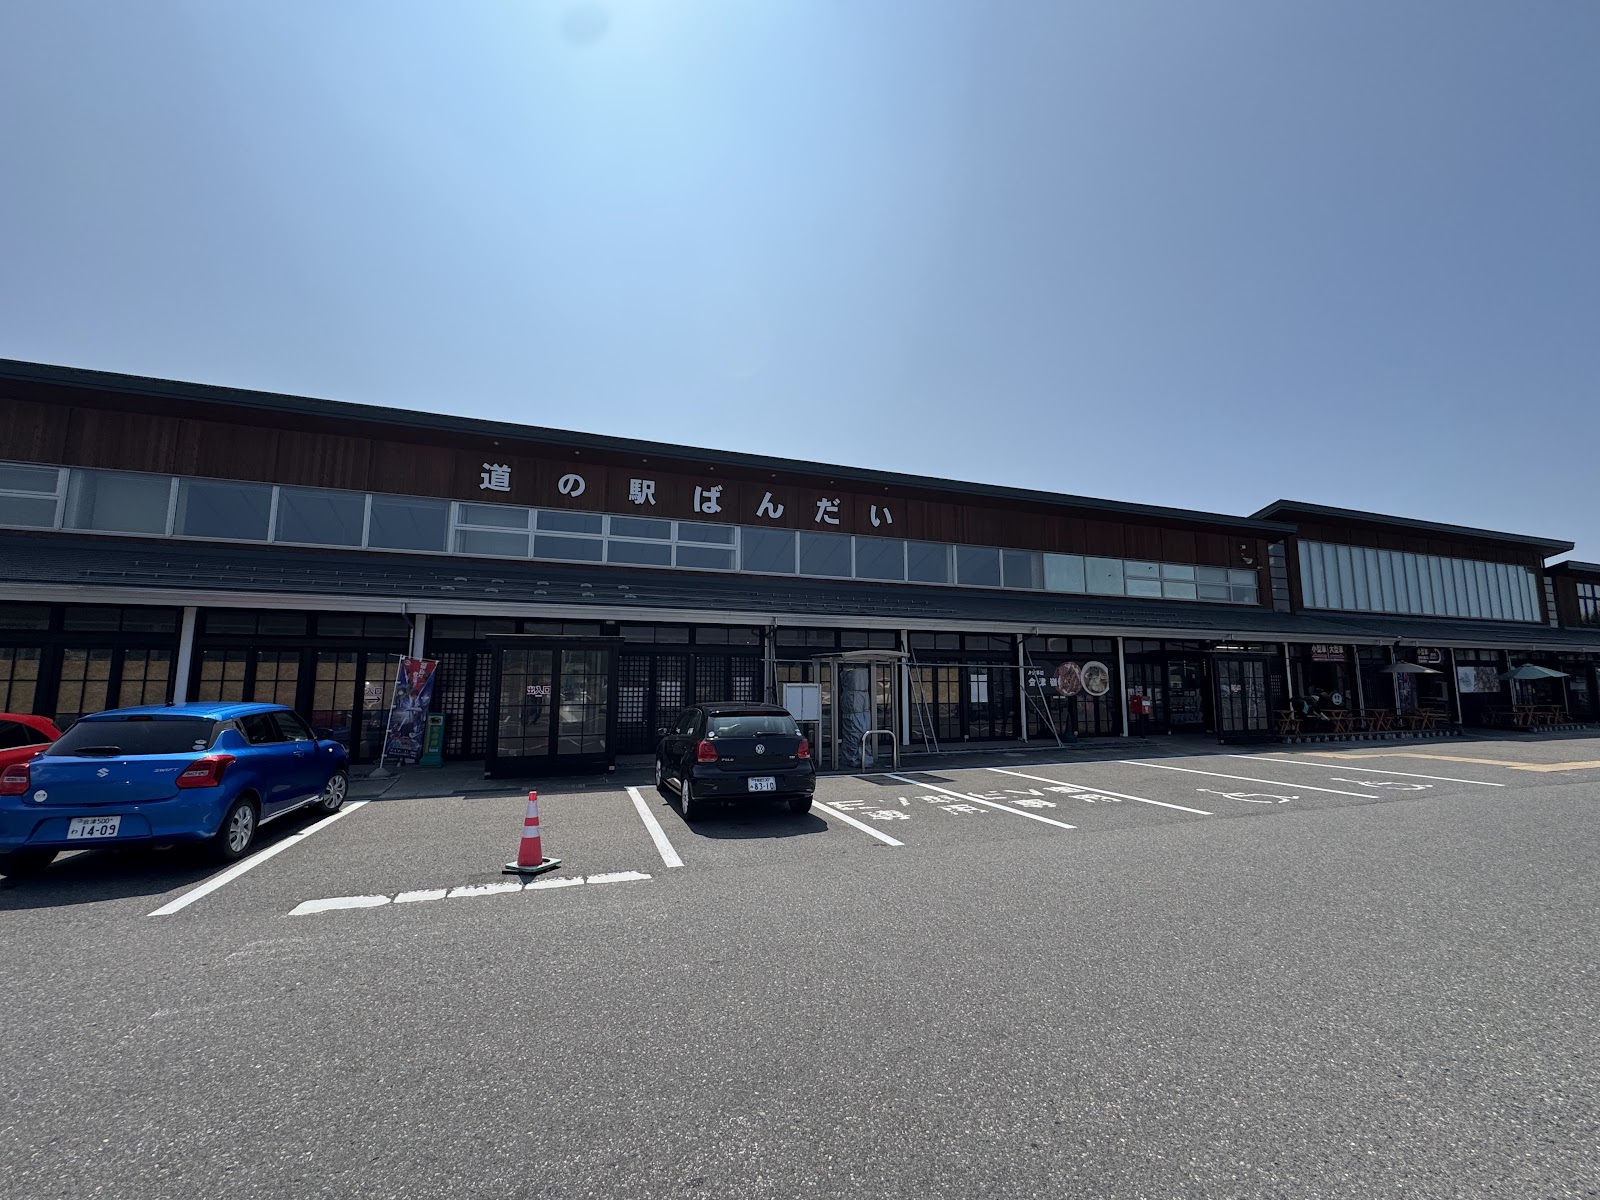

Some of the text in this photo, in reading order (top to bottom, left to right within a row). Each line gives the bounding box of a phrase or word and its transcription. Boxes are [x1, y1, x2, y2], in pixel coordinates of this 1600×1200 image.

[479, 462, 893, 528] 道の駅ばんだい
[365, 687, 383, 695] 入口
[526, 685, 551, 695] 出入口
[754, 782, 774, 790] 83-10
[80, 825, 116, 836] 14-09
